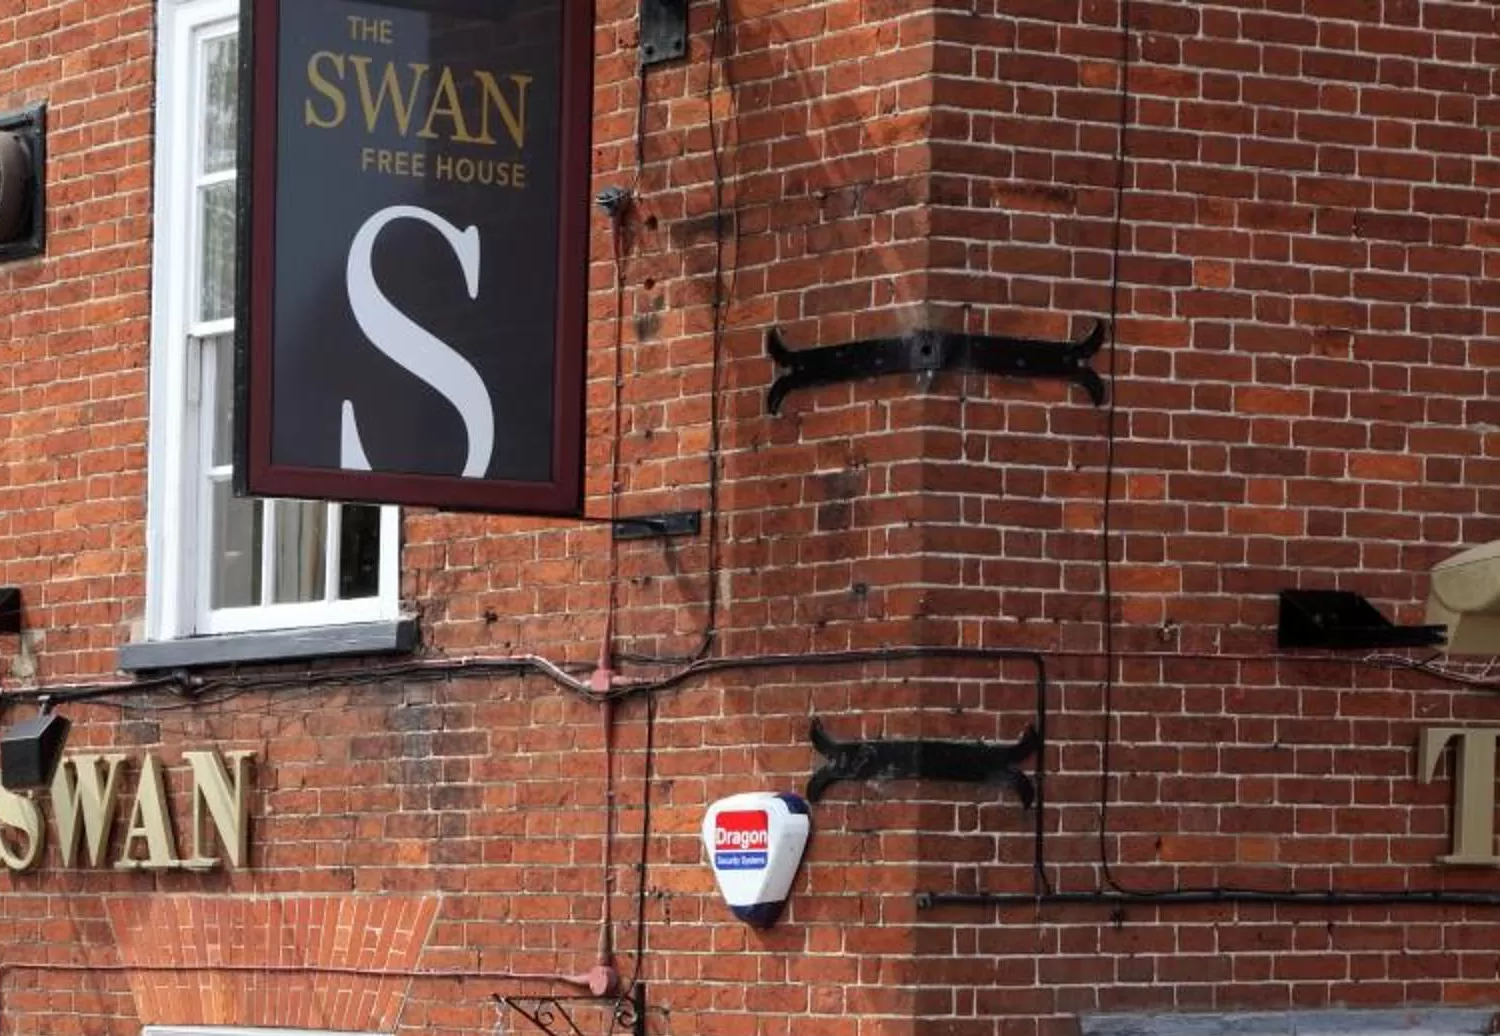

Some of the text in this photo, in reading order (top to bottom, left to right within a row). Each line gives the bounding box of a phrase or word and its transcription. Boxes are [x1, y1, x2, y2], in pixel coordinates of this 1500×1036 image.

[348, 15, 394, 45] THE
[306, 50, 532, 150] SWAN
[362, 148, 526, 188] FREE HOUSE
[341, 205, 495, 479] S
[715, 827, 767, 848] Dragon
